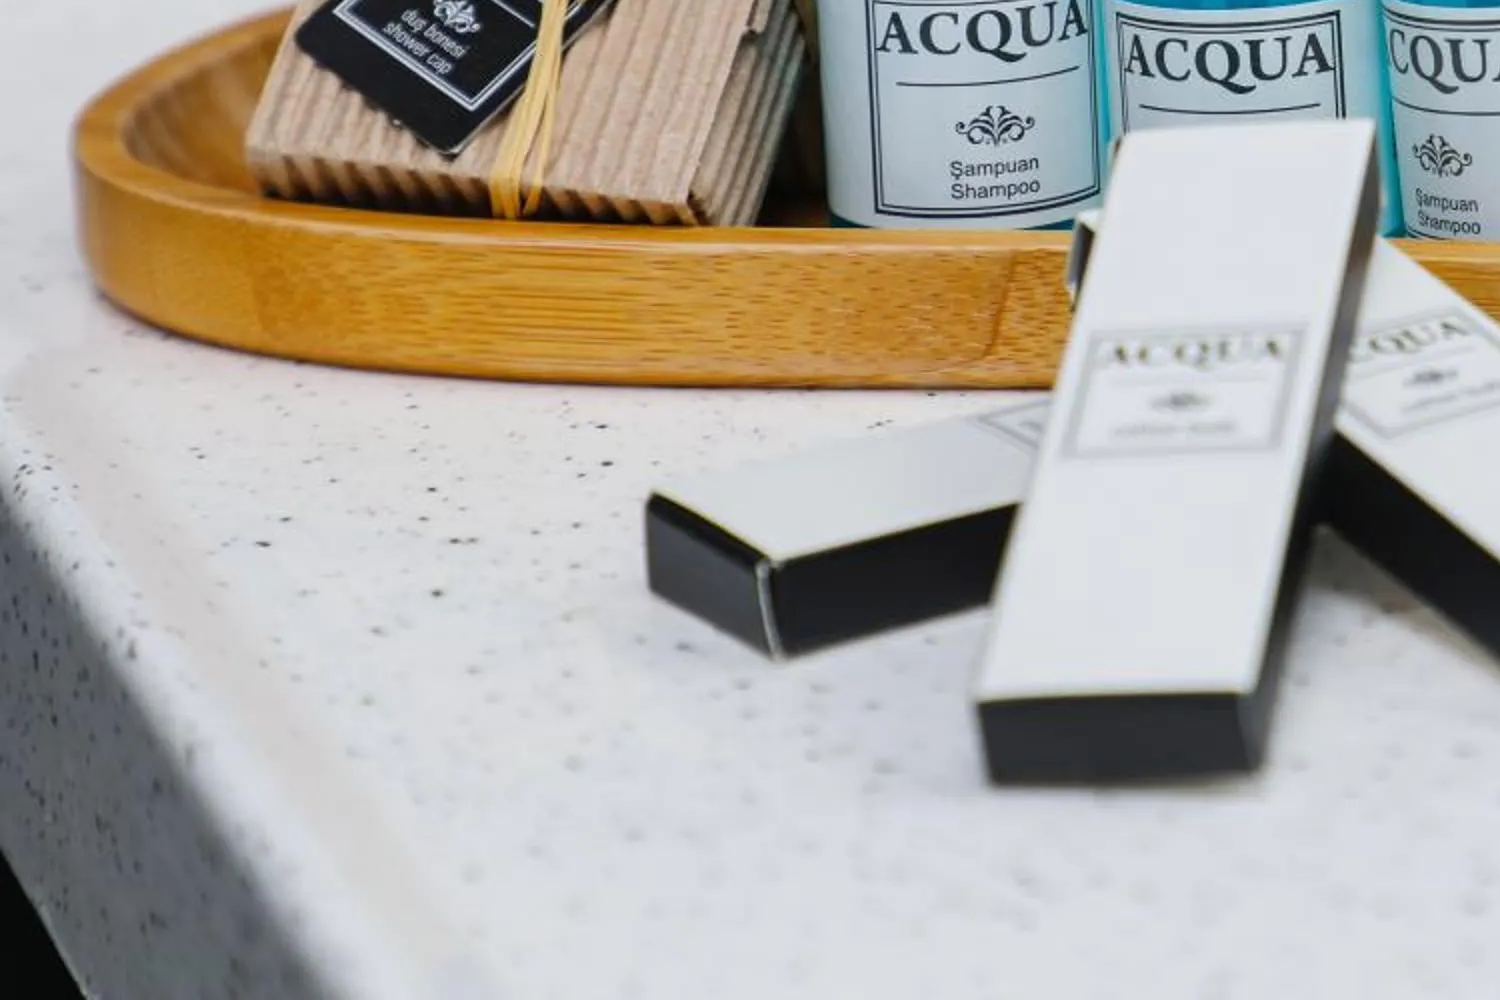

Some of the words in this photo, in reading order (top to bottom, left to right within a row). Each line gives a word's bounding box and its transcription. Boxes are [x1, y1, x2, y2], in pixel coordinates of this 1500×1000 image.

[383, 22, 431, 57] shower
[427, 53, 453, 76] cap
[1124, 32, 1336, 94] ACQUA
[950, 157, 1040, 180] Şampuan
[951, 180, 1041, 200] Shampoo
[1418, 210, 1481, 237] Shampoo
[1103, 336, 1287, 369] ACQUA
